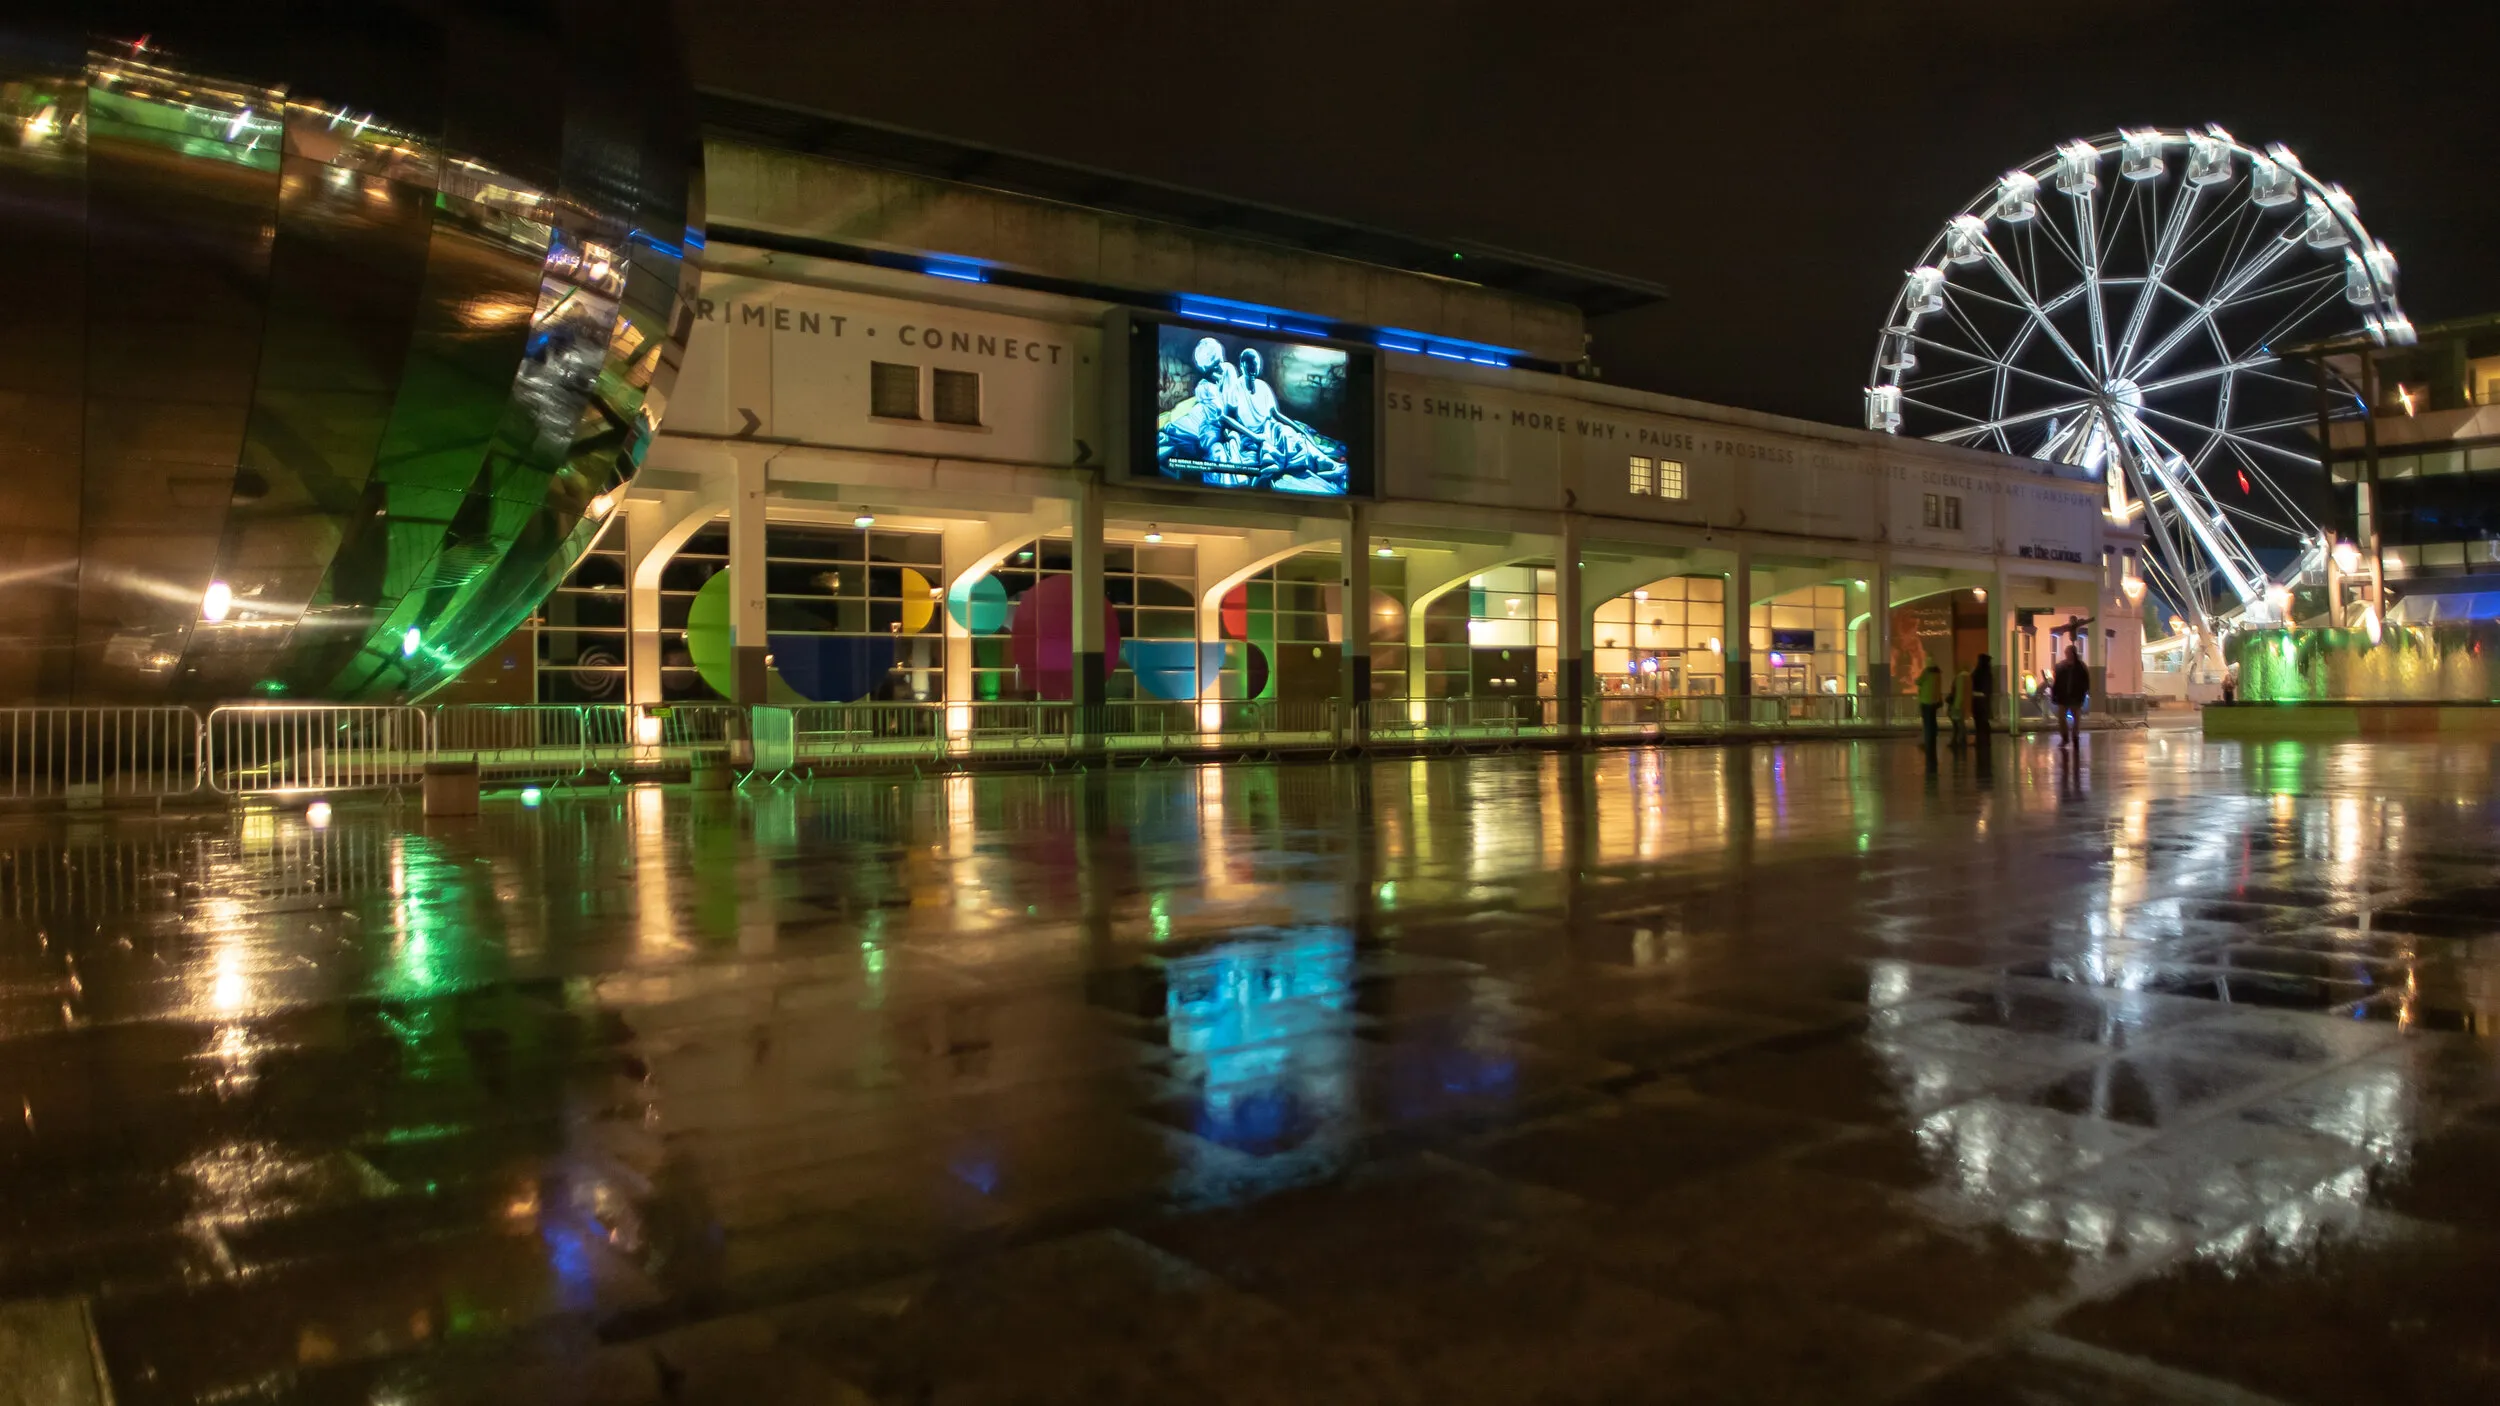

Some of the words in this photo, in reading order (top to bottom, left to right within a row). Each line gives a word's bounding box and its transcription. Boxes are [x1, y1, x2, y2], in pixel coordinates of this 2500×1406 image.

[697, 297, 847, 337] RIMENT
[898, 324, 1062, 365] CONNECT
[1423, 396, 1484, 421] SHHH
[1511, 409, 1567, 433] MORE
[1576, 420, 1616, 440] WHY
[1639, 428, 1694, 451] PAUSE
[1714, 440, 1795, 465] PROGRESS
[1922, 470, 1972, 491] SCIENCE
[2034, 544, 2049, 560] the
